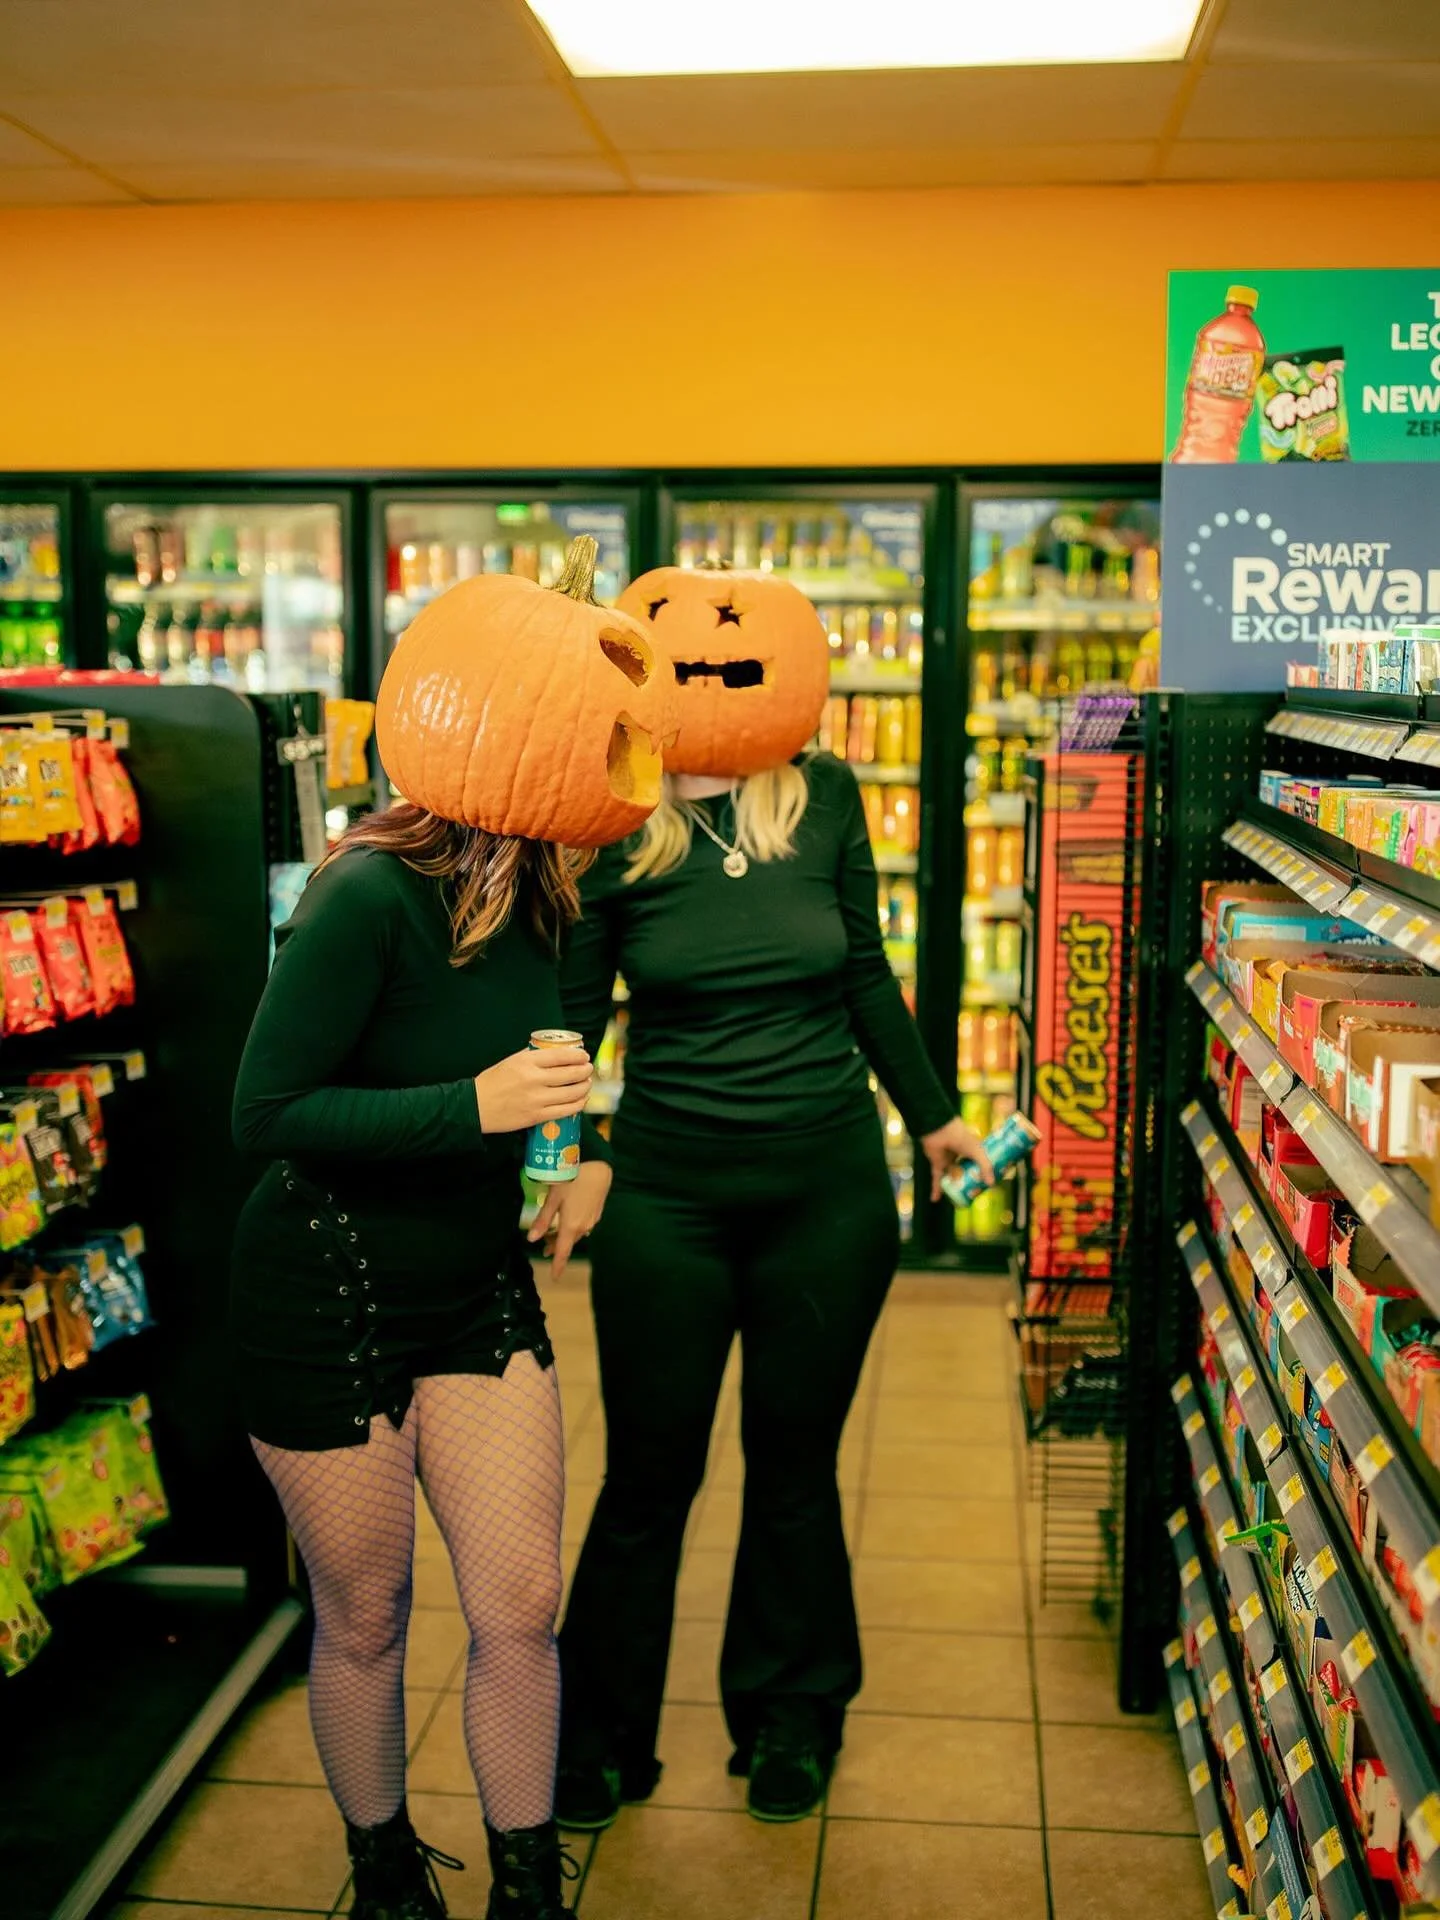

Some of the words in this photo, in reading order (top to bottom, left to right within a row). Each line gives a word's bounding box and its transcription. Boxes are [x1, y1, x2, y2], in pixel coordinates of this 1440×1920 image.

[1264, 375, 1338, 431] Trolli
[1363, 385, 1440, 413] NEW
[1287, 542, 1391, 567] SMART
[1036, 912, 1111, 1139] Reese's
